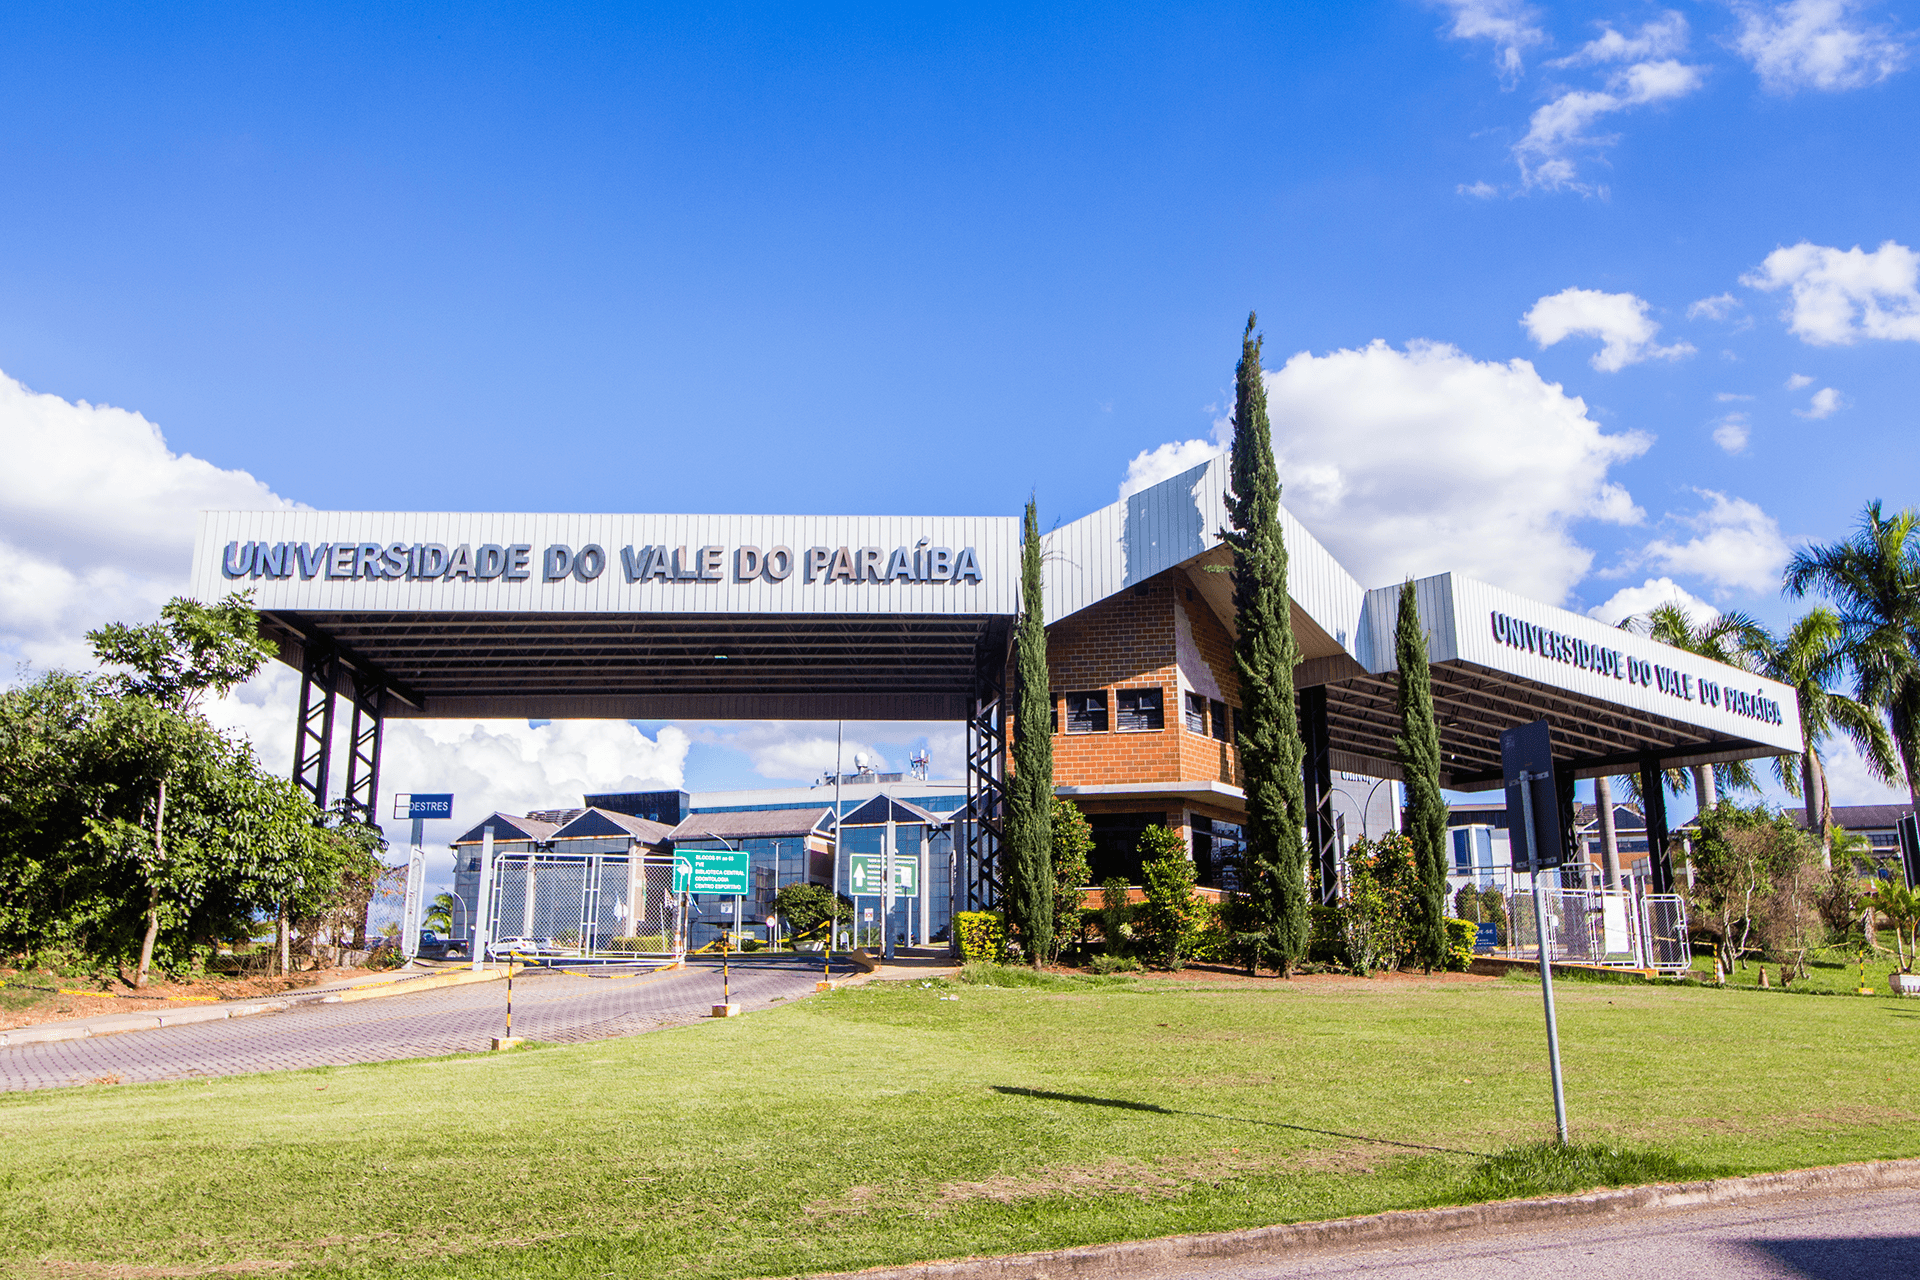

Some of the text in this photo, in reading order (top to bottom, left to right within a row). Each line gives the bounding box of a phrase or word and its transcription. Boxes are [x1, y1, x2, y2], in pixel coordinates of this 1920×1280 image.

[223, 536, 983, 585] UNIVERSIDADE DO VALE DO PARAÍBA
[1491, 610, 1783, 726] UNIVERSIDADE DO VALE DO PARAÍBA
[410, 801, 449, 811] DESTRES
